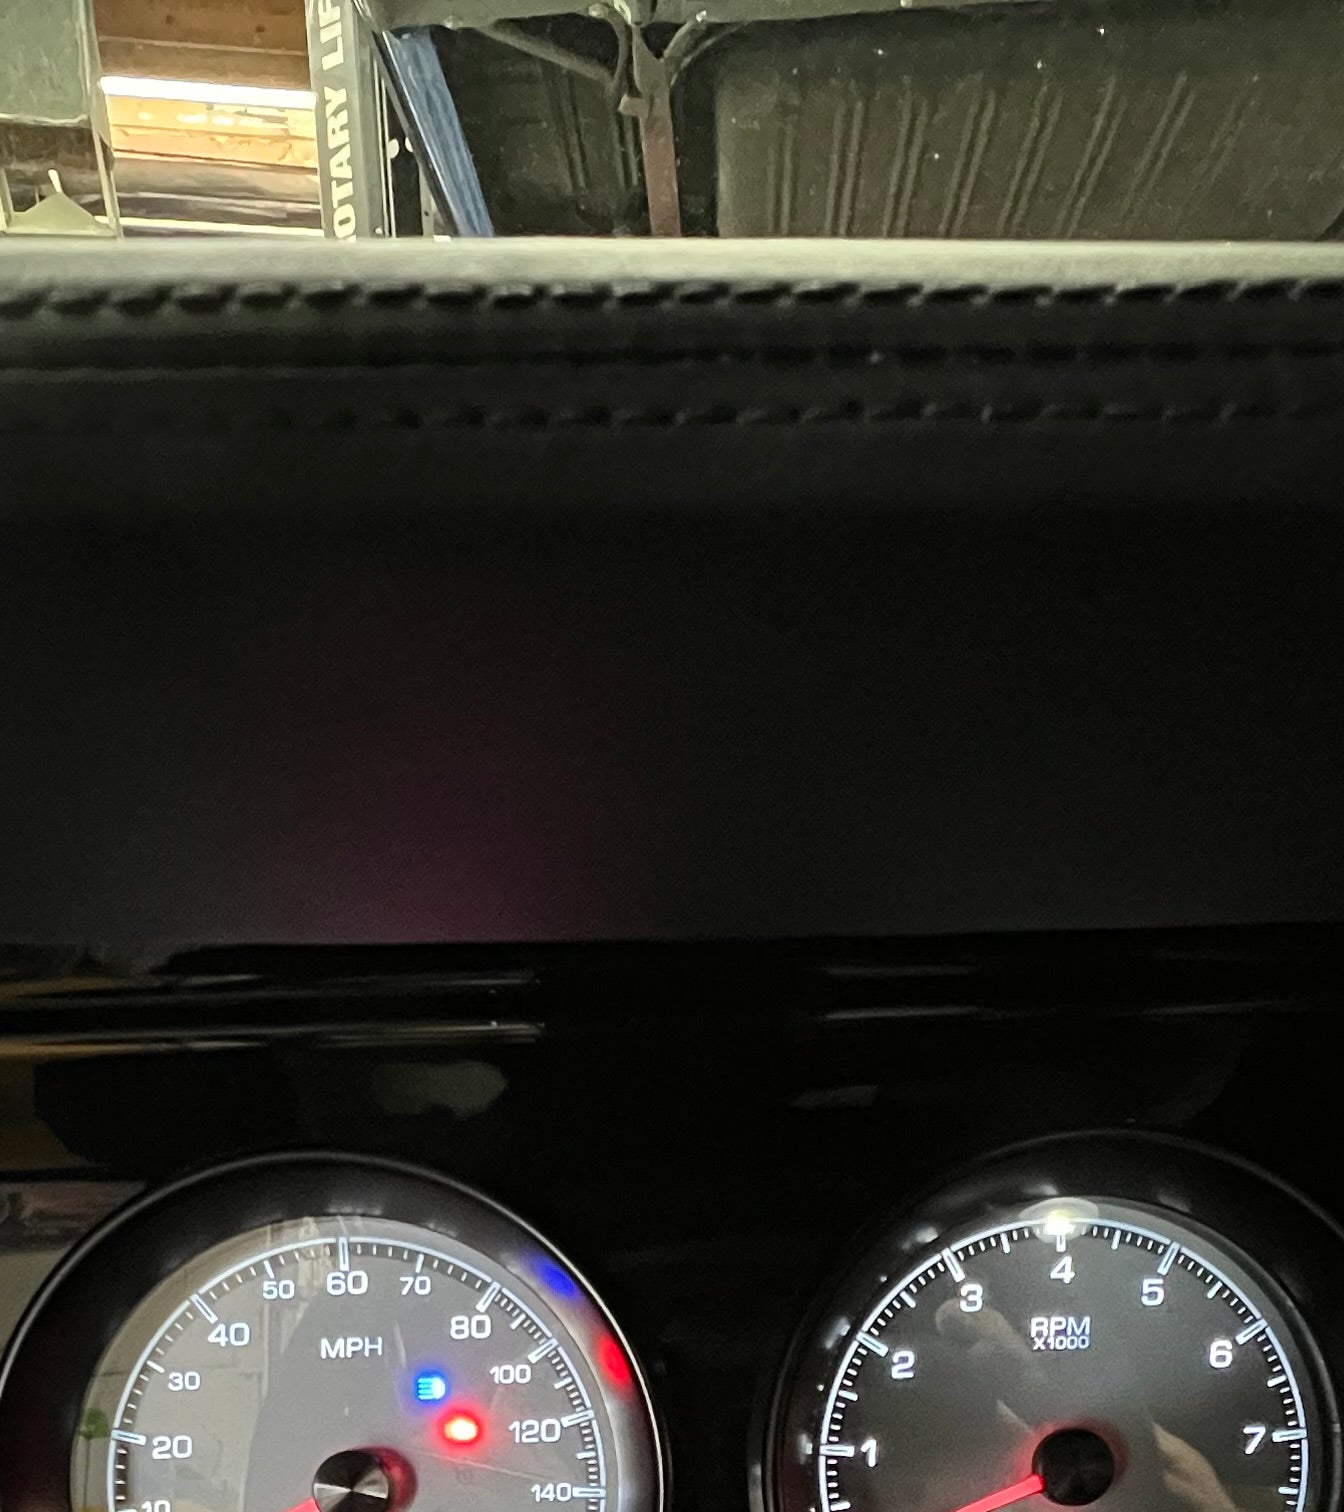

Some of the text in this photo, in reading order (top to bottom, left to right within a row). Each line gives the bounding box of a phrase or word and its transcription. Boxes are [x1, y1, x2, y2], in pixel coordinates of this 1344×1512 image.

[323, 87, 356, 242] OTARY
[1049, 1255, 1075, 1284] 4
[262, 1280, 295, 1299] 50
[326, 1270, 368, 1296] 60
[399, 1276, 431, 1296] 70
[1140, 1278, 1164, 1306] 5
[959, 1284, 984, 1313] 3
[208, 1322, 250, 1346] 40
[450, 1314, 492, 1339] 80
[1030, 1316, 1091, 1338] RPM
[320, 1336, 383, 1359] MPH
[1209, 1339, 1233, 1368] 6
[489, 1364, 532, 1384] 100
[891, 1350, 915, 1379] 2
[168, 1371, 201, 1391] 30
[508, 1418, 561, 1443] 120
[1243, 1425, 1266, 1455] 7
[152, 1435, 193, 1460] 20
[860, 1437, 877, 1467] 1
[531, 1482, 572, 1502] 140
